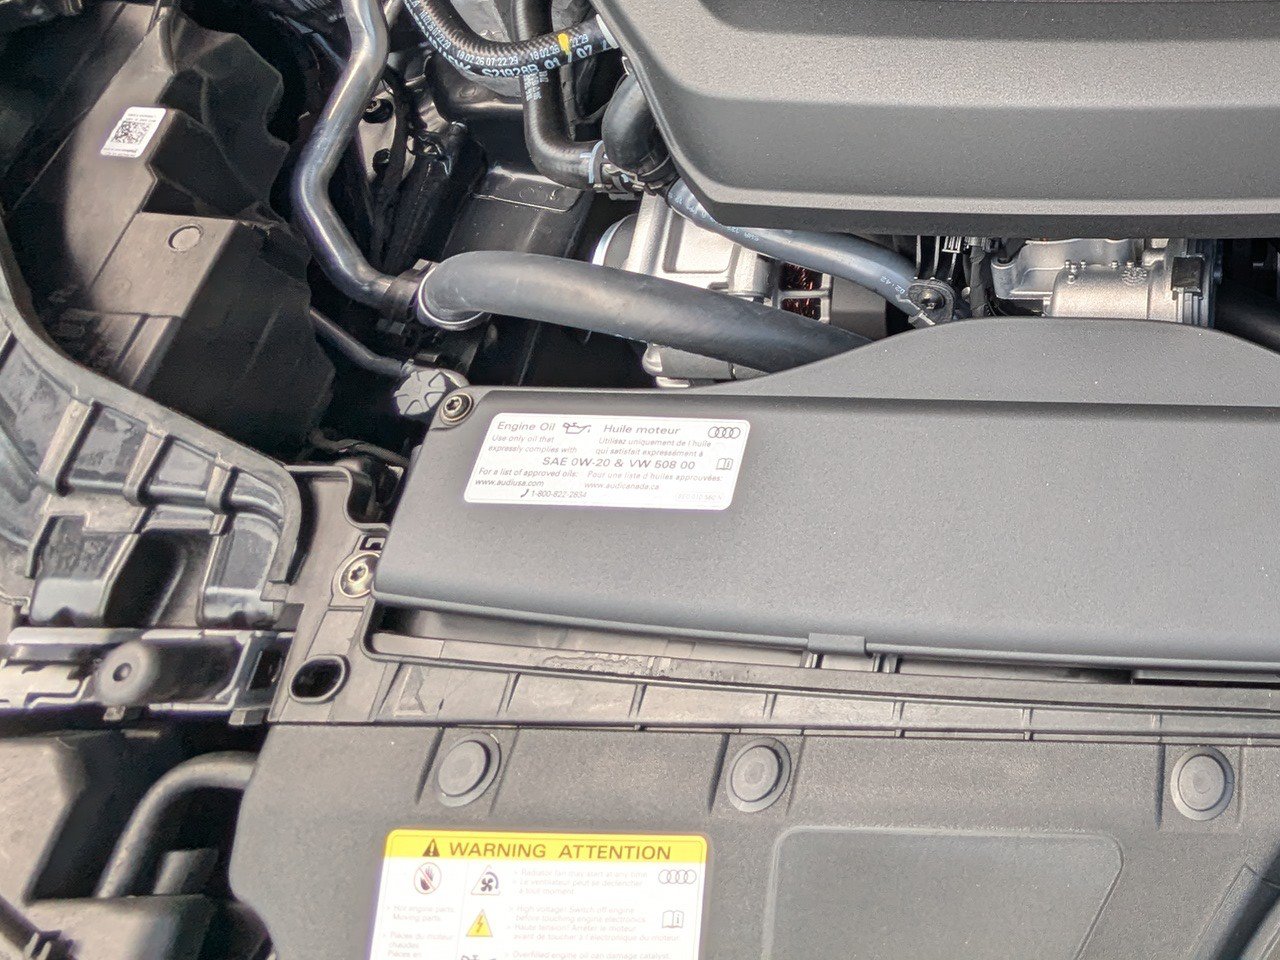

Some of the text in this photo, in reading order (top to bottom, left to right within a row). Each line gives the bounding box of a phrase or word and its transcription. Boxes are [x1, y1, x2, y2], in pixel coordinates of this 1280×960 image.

[497, 421, 556, 432] Engine Oil
[603, 424, 681, 435] Huile moteur
[508, 435, 525, 443] only
[628, 438, 675, 448] uniquement
[488, 445, 524, 453] expressly
[525, 445, 559, 454] complies
[542, 456, 695, 470] SAE 0W-20 & VW 508 00
[478, 467, 492, 475] For
[499, 467, 512, 476] list
[513, 468, 523, 476] of
[523, 469, 561, 478] approved
[475, 479, 544, 487] www.audiusa.com
[584, 482, 659, 490] www.audicanada.ca
[531, 490, 587, 498] 1-800-822-2834
[450, 842, 672, 861] WARNING ATTENTION
